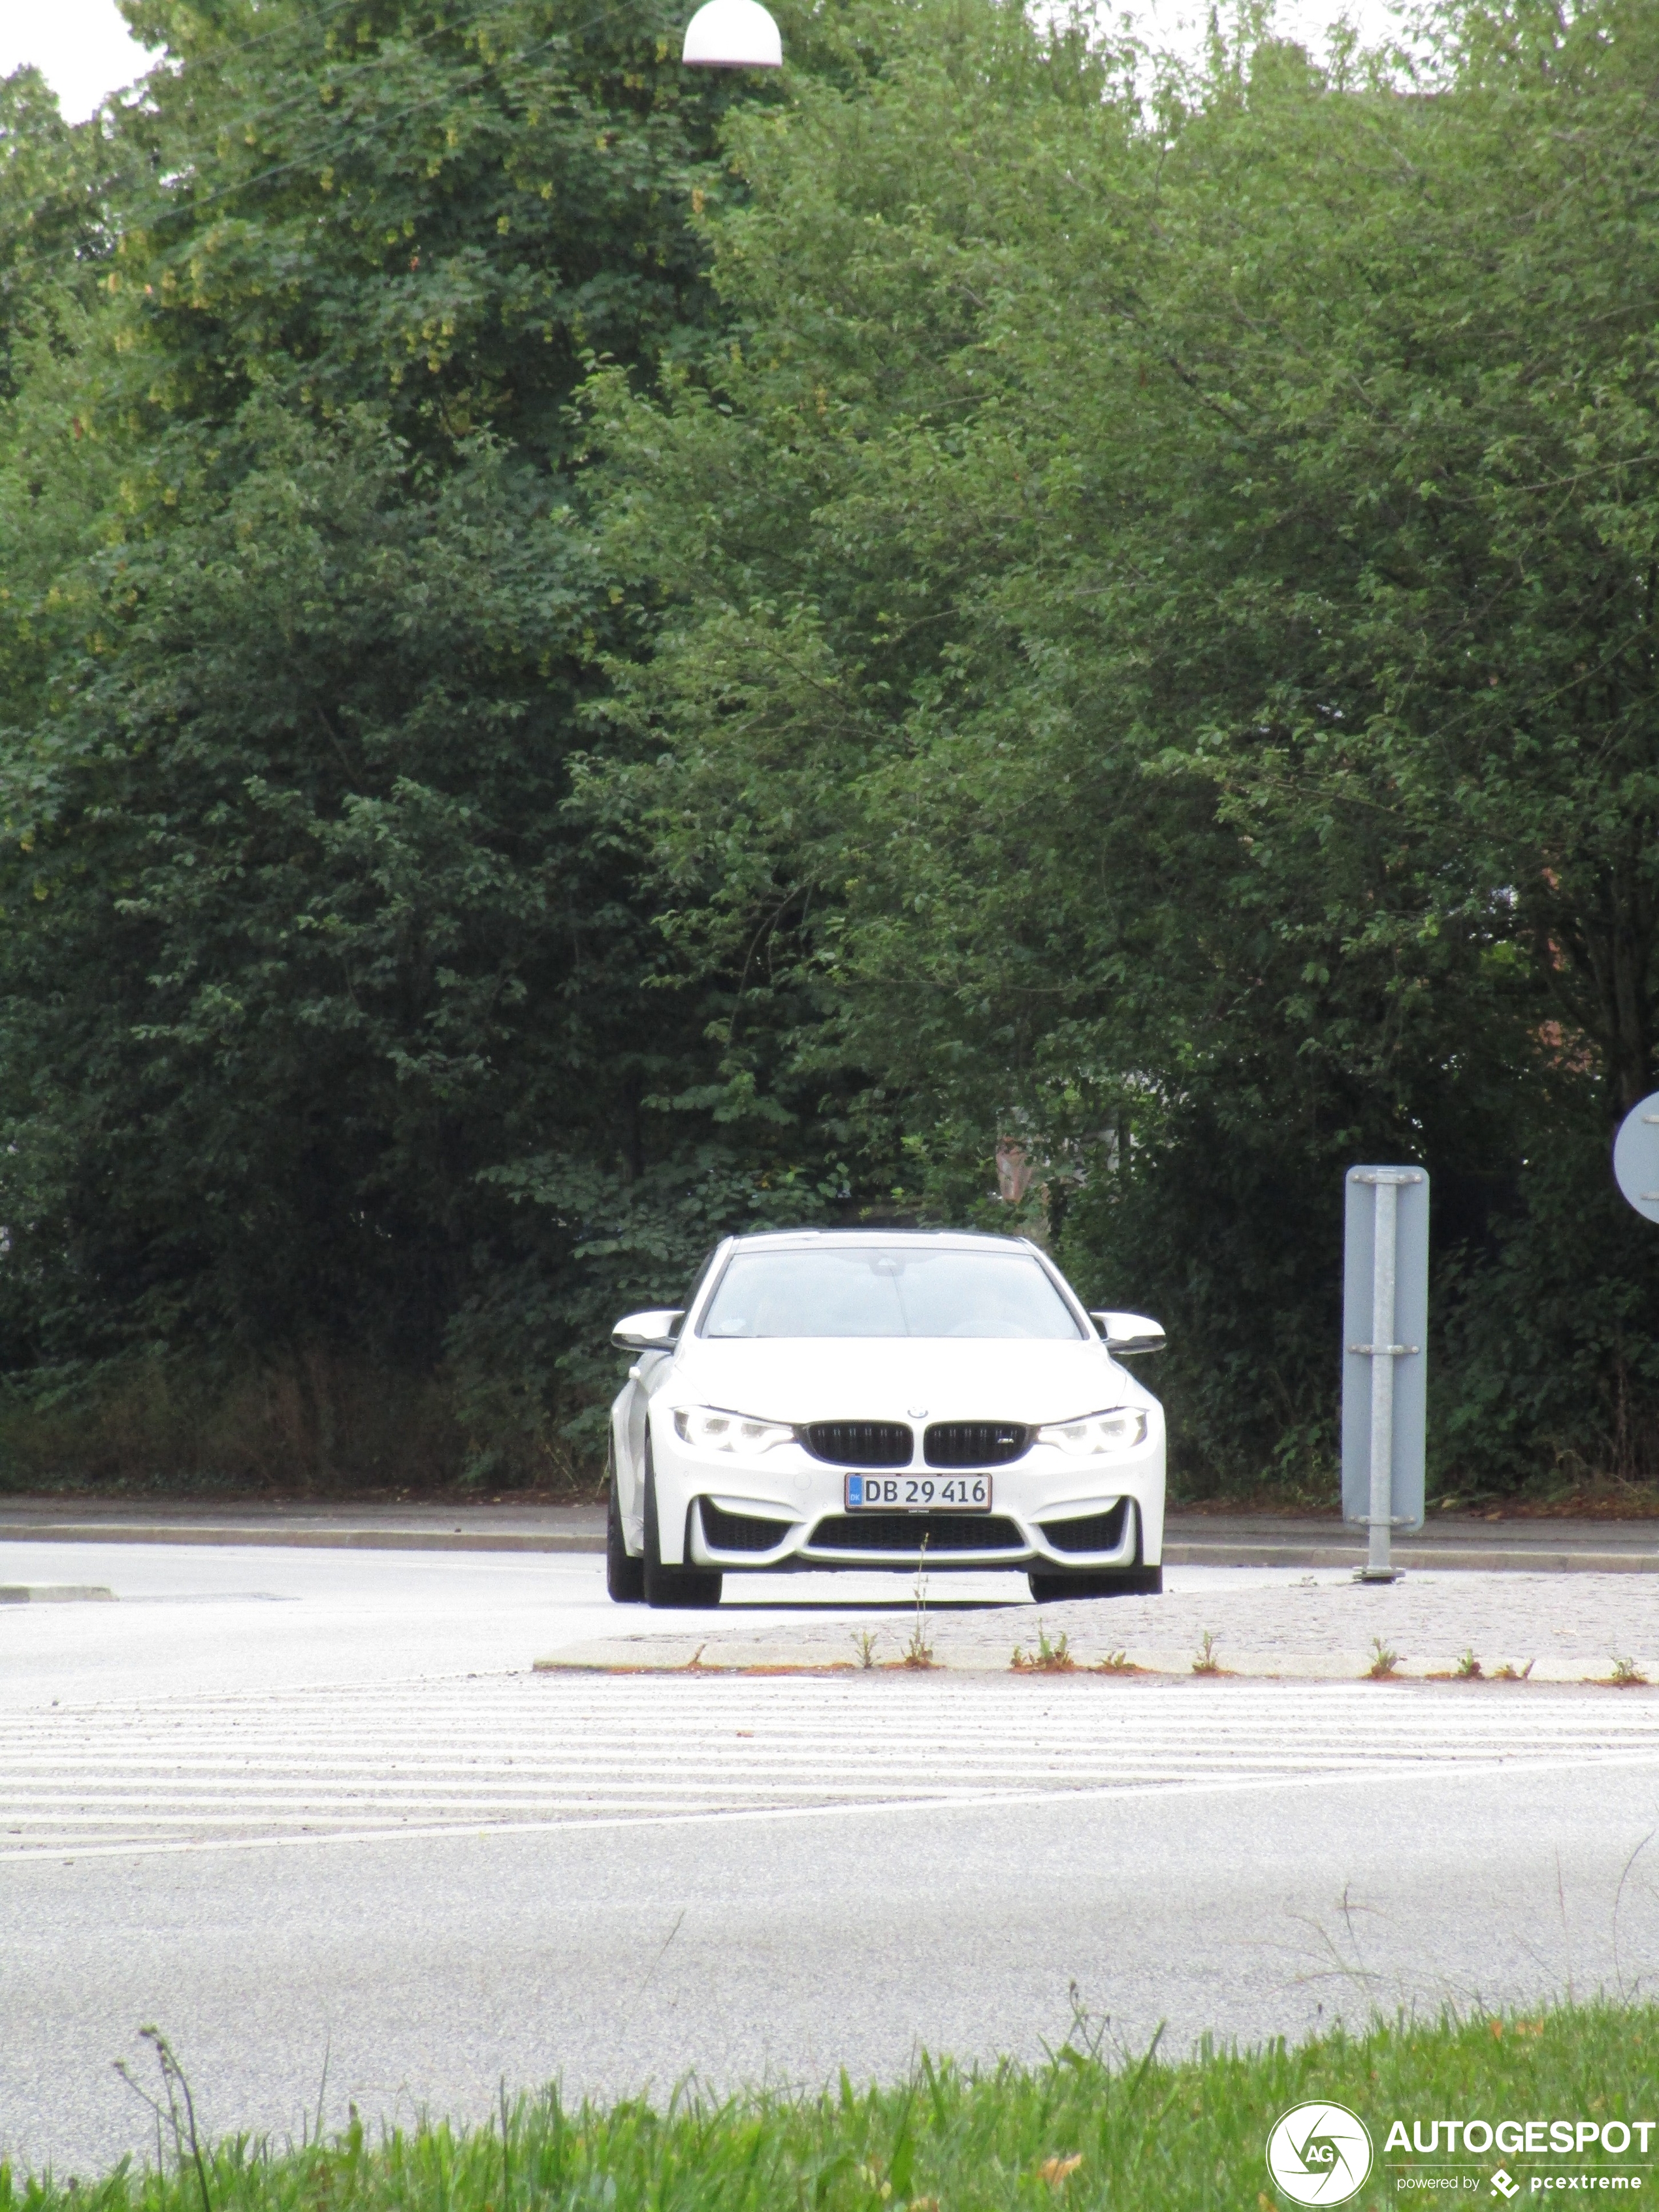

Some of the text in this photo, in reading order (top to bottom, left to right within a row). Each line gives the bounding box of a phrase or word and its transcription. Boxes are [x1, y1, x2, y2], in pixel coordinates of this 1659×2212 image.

[866, 1480, 985, 1502] DB 29 416
